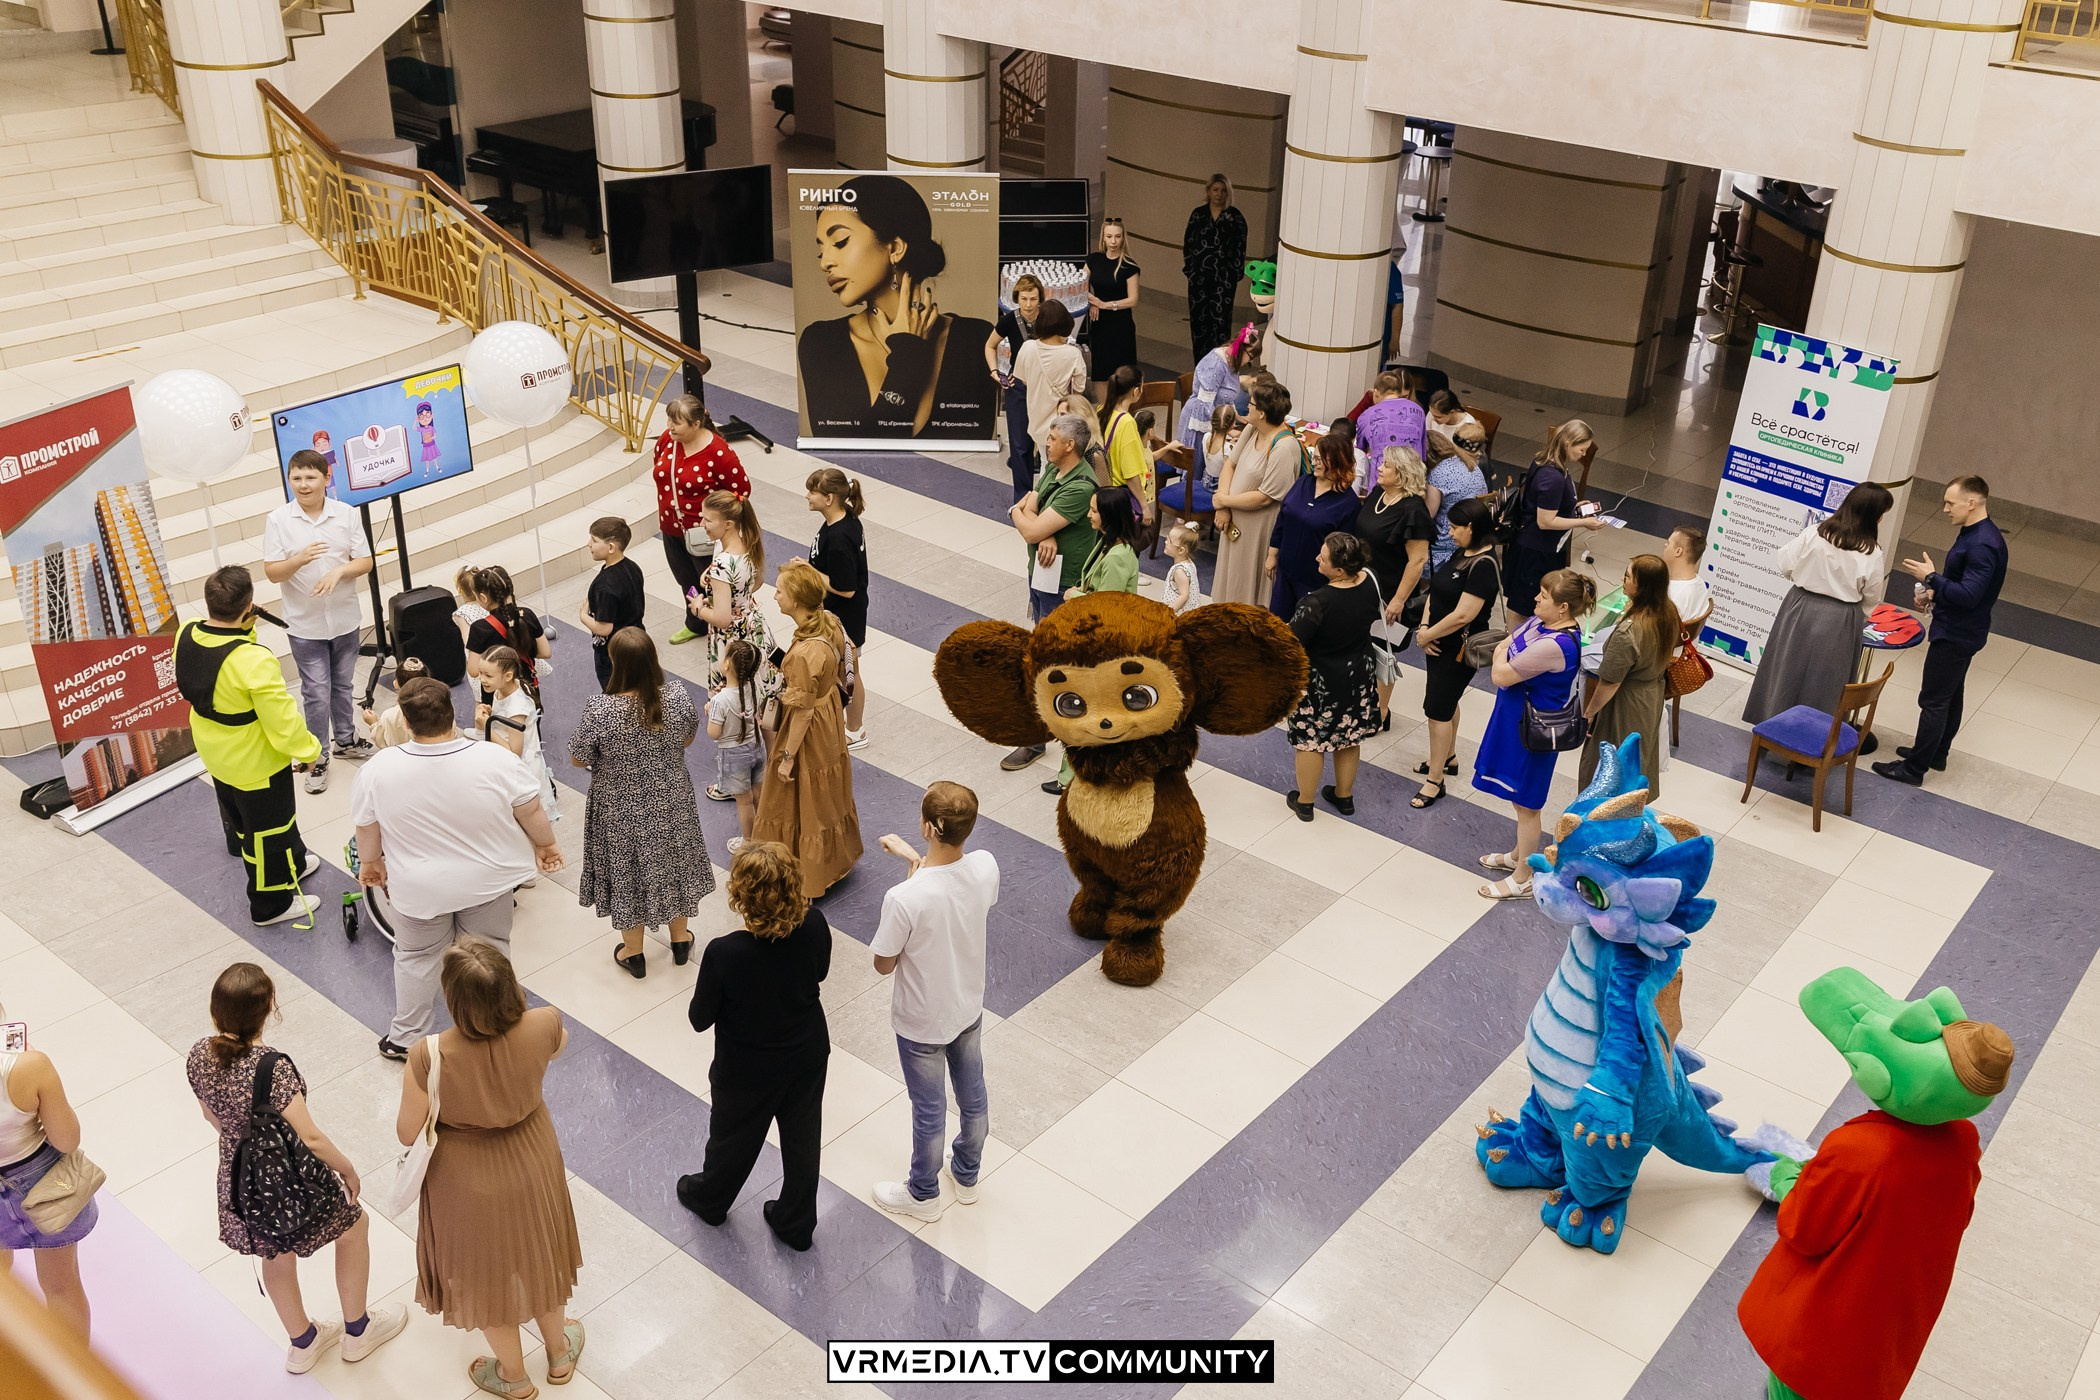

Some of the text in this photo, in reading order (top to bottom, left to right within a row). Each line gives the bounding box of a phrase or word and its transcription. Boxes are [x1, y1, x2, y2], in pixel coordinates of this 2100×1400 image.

[799, 188, 858, 203] РИНГО
[799, 204, 838, 212] ЮВЕЛИРНЫЙ
[414, 373, 452, 390] ДЕВОЧКИ
[536, 362, 572, 382] ПРОМСТРО
[1750, 412, 1861, 455] Всё срастётся!
[20, 427, 100, 470] ПРОМСТРОЙ
[1759, 432, 1843, 462] ОРТОПЕДИЧЕСКАЯ КЛИНИКА
[24, 460, 58, 476] КОМПАНИЯ
[362, 456, 396, 472] УДОЧКА
[1733, 500, 1788, 521] ортопедических
[1734, 493, 1781, 512] изготовление
[1728, 517, 1756, 530] терапия
[1730, 510, 1765, 526] локальная
[1724, 534, 1751, 547] терапия
[1721, 546, 1747, 557] массаж
[1712, 610, 1726, 618] рача
[1737, 618, 1770, 635] спортивн
[1746, 629, 1762, 640] ЛФК
[53, 643, 147, 694] НАДЕЖНОСТЬ
[57, 669, 127, 710] КАЧЕСТВО
[62, 687, 125, 729] ДОВЕРИЕ
[110, 704, 139, 721] Телефон
[138, 695, 161, 709] отдела
[111, 720, 123, 730] +7
[124, 706, 152, 732] (3842)
[153, 701, 164, 711] 77
[165, 695, 177, 706] 33
